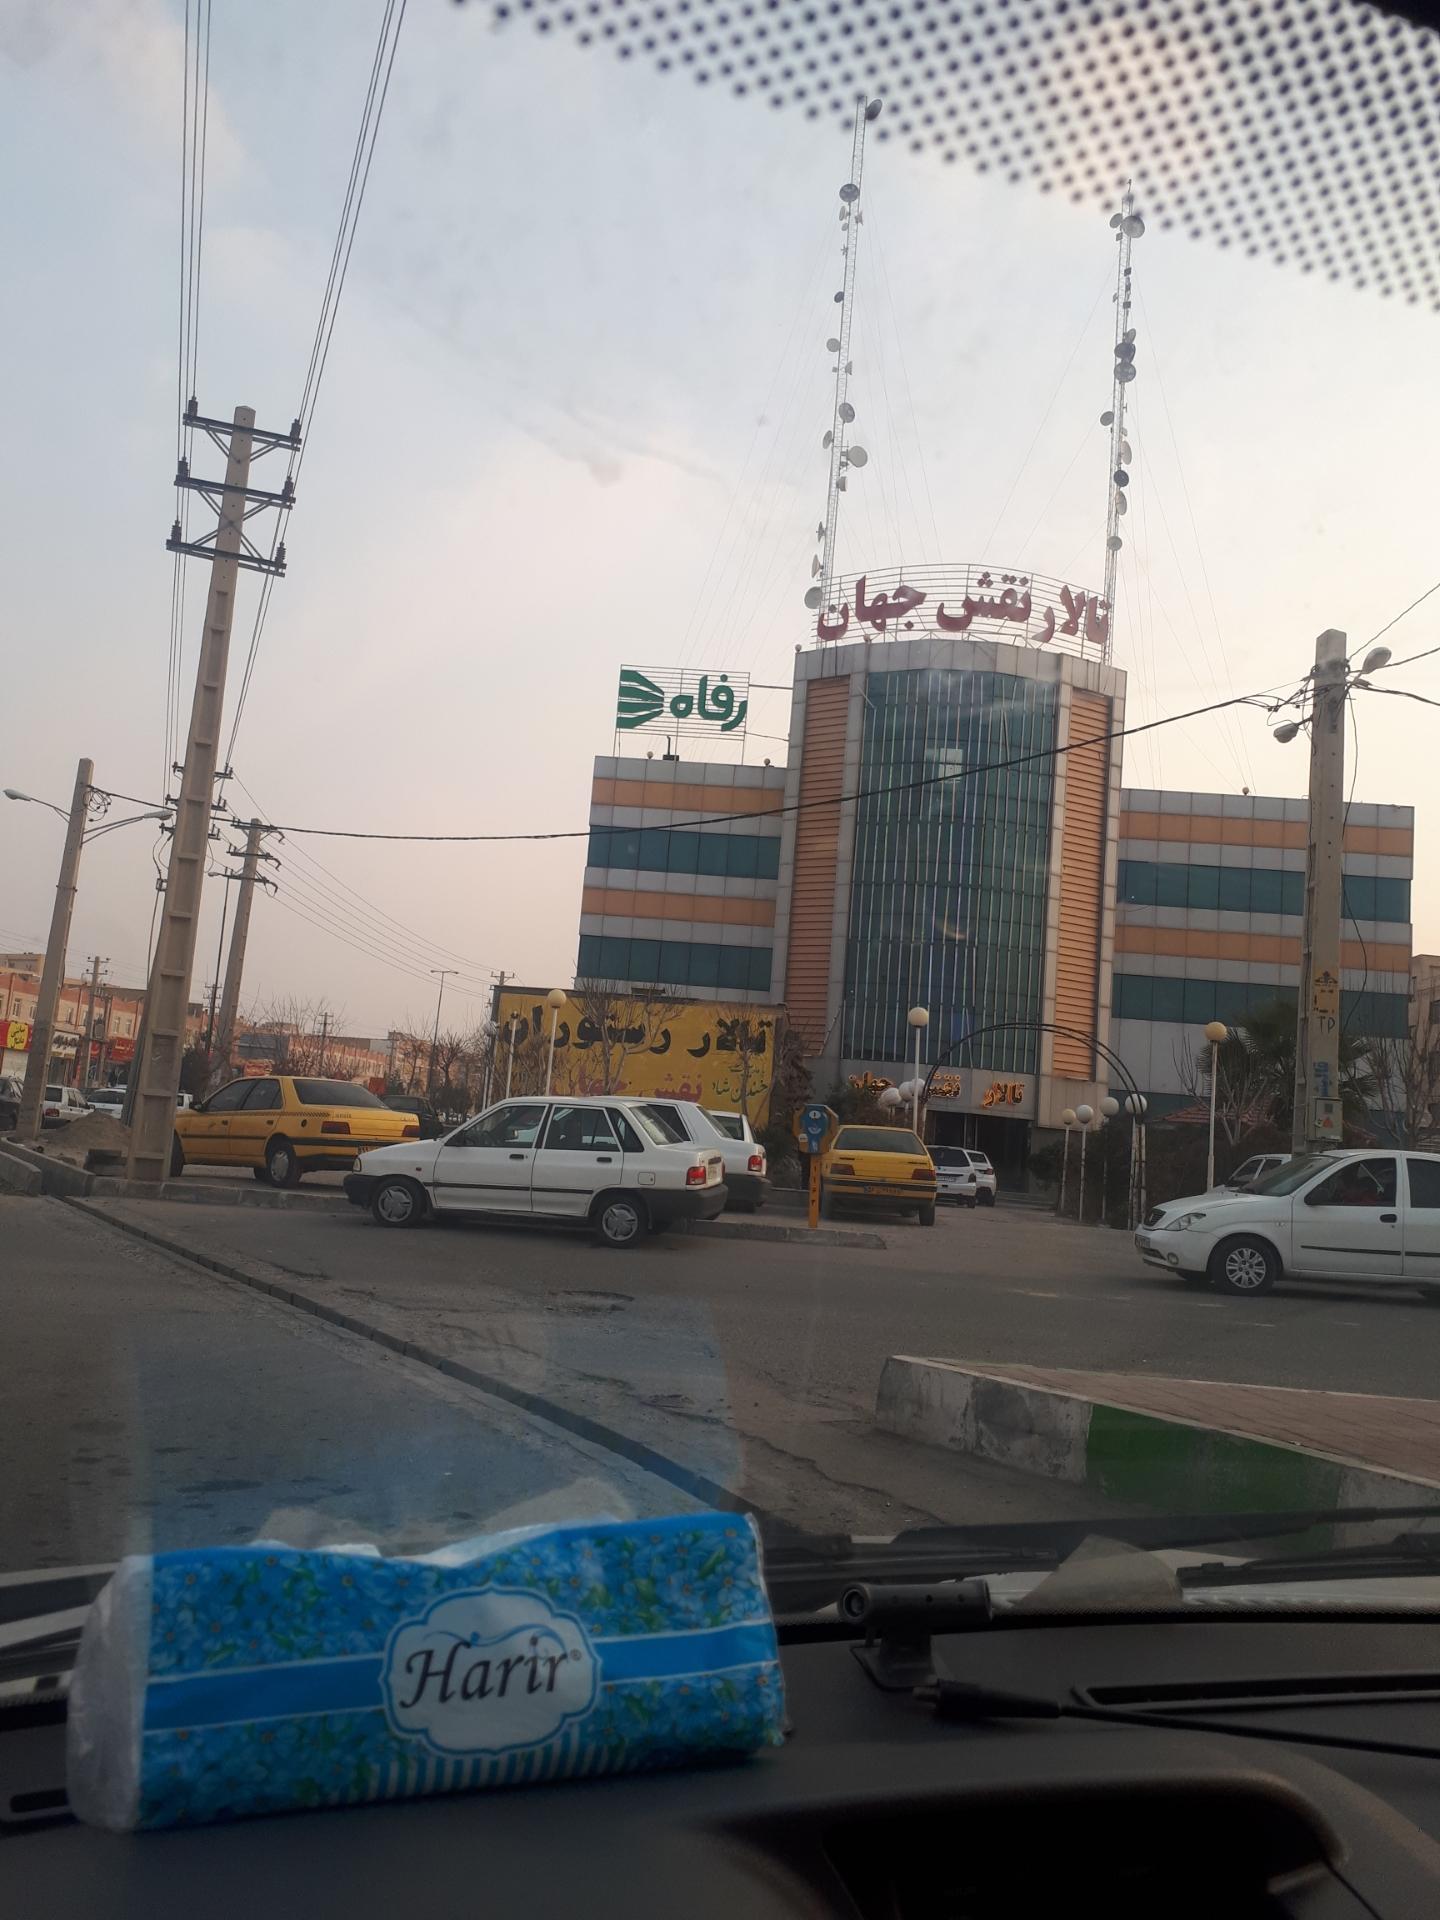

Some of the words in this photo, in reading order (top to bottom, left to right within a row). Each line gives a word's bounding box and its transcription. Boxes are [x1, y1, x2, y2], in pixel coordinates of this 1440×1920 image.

[817, 575, 927, 641] جهان
[937, 571, 1031, 632] نقش
[1031, 584, 1111, 644] تالار
[670, 674, 748, 732] رفاه
[503, 1005, 672, 1054] رستوران
[399, 1635, 569, 1710] Harir
